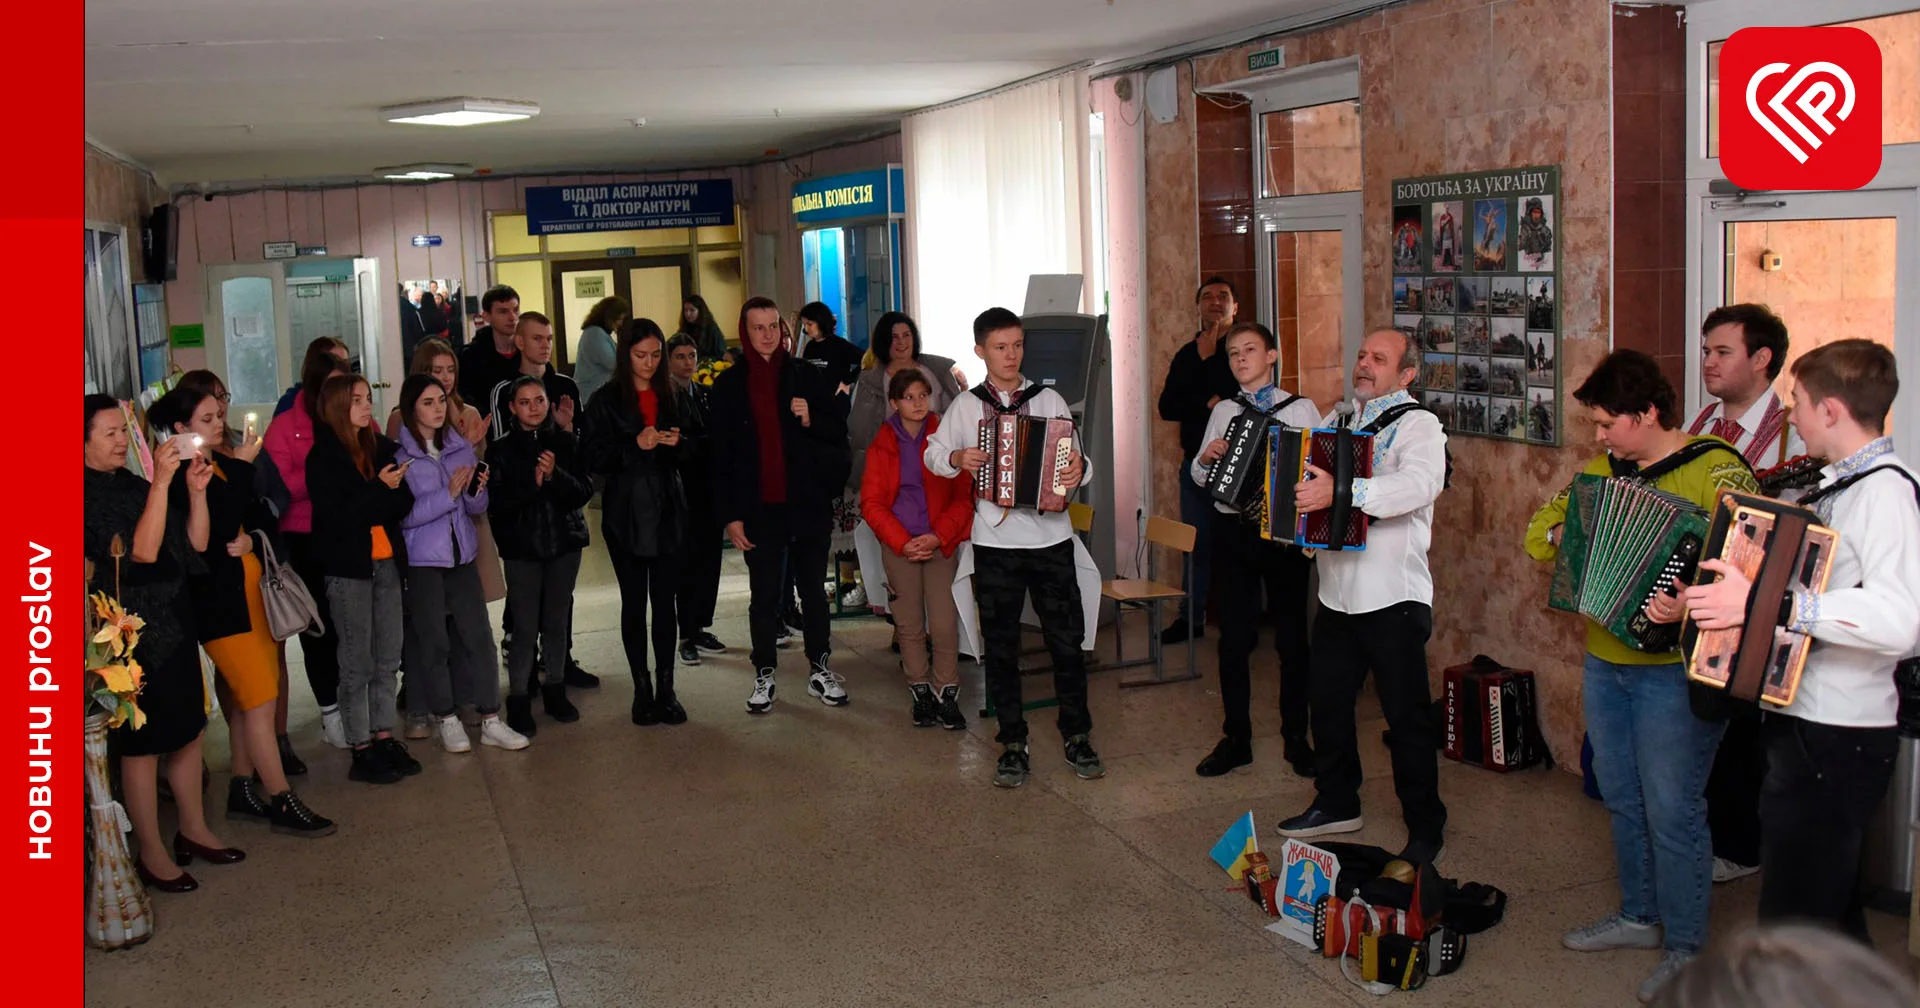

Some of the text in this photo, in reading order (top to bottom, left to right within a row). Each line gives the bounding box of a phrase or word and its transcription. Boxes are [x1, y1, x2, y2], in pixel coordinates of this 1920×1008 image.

[1250, 51, 1277, 69] ВИХІД
[562, 183, 699, 203] ВІДДІЛ АСПІРАНТУРИ
[825, 184, 874, 208] КОМІСІЯ
[1397, 171, 1549, 200] БОРОТЬБА ЗА УКРАЇНУ
[572, 199, 691, 218] ТА ДОКТОРАНТУРИ
[541, 216, 721, 233] DEPARTMENT OF POSTGRADUATE AND DOCTORAL STUDIES
[1000, 421, 1014, 499] ВУСИК
[1217, 419, 1254, 494] НАГОРНЮК
[1447, 681, 1456, 751] НАГОРНЮК
[1287, 841, 1333, 879] ЖАШКІВ
